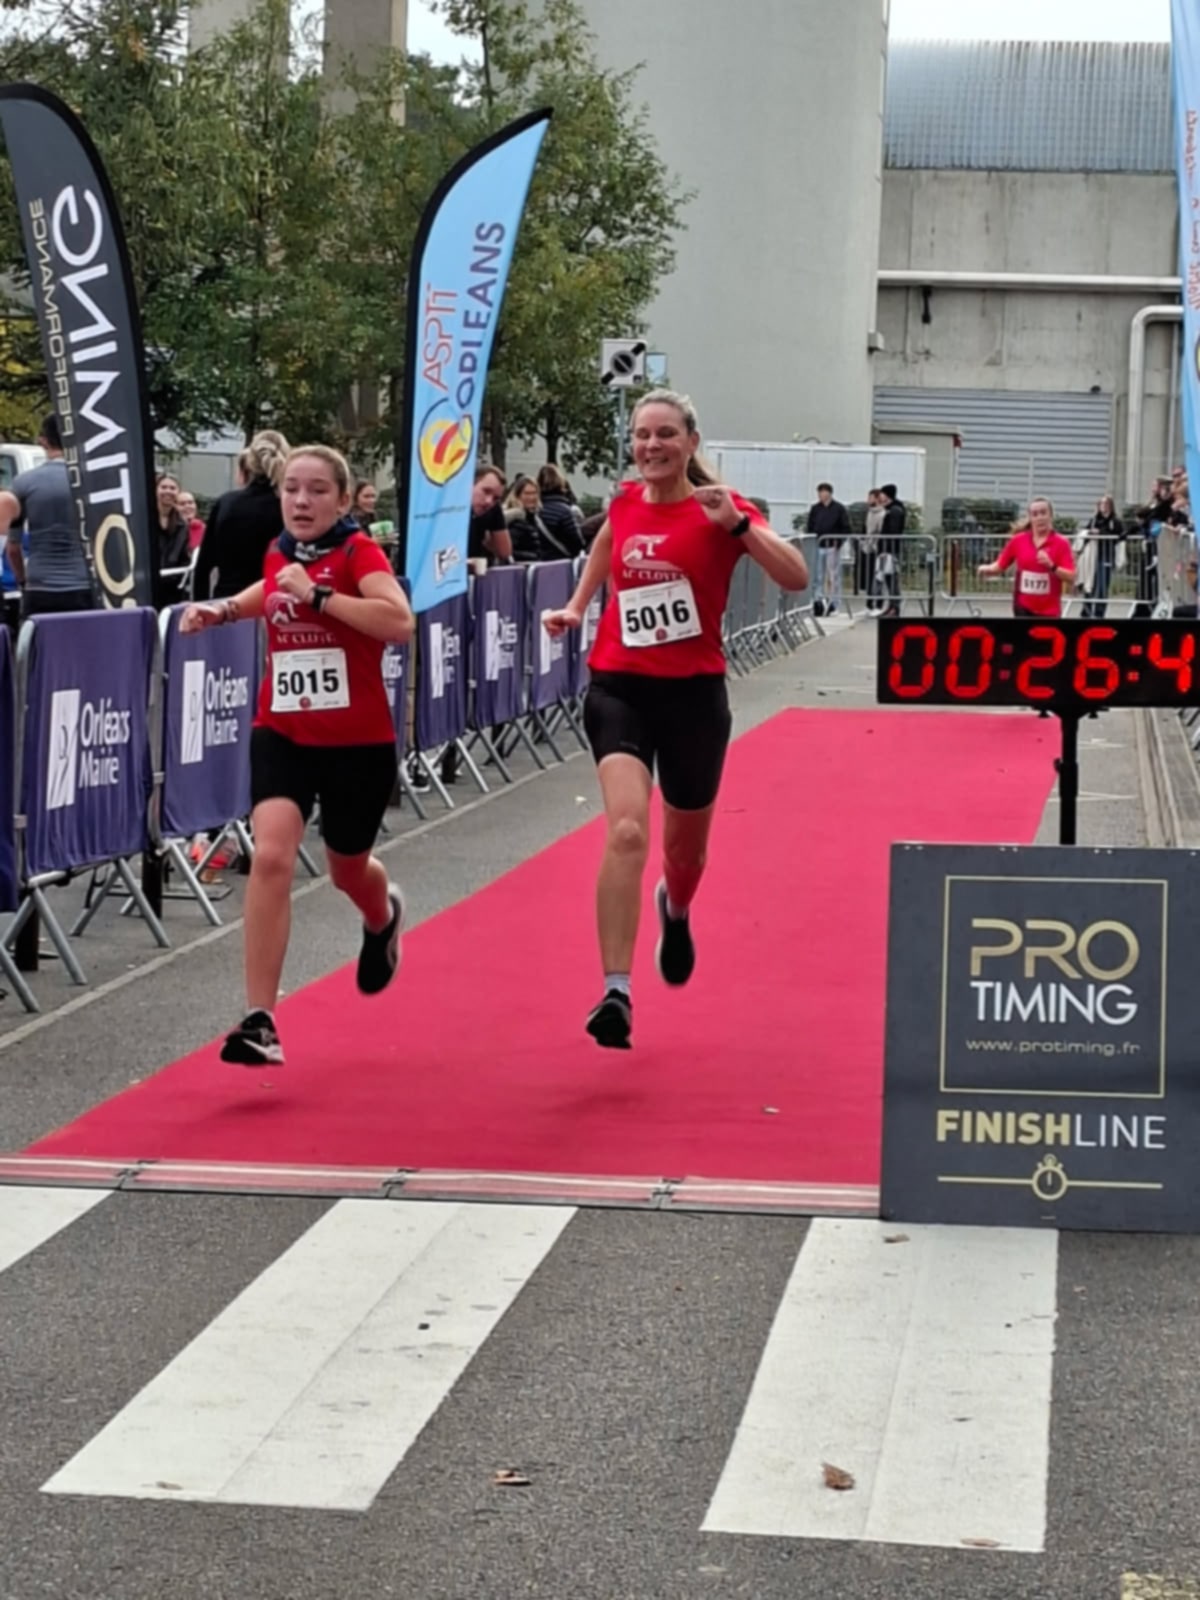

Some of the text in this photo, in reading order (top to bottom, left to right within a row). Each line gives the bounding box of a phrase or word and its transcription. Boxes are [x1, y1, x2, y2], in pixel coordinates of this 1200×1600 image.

[626, 599, 690, 633] 5016
[206, 666, 248, 711] Orléans
[277, 668, 339, 697] 5015
[970, 917, 1140, 981] PRO
[970, 981, 1138, 1025] TIMING
[966, 1039, 1140, 1057] www.protiming.fr
